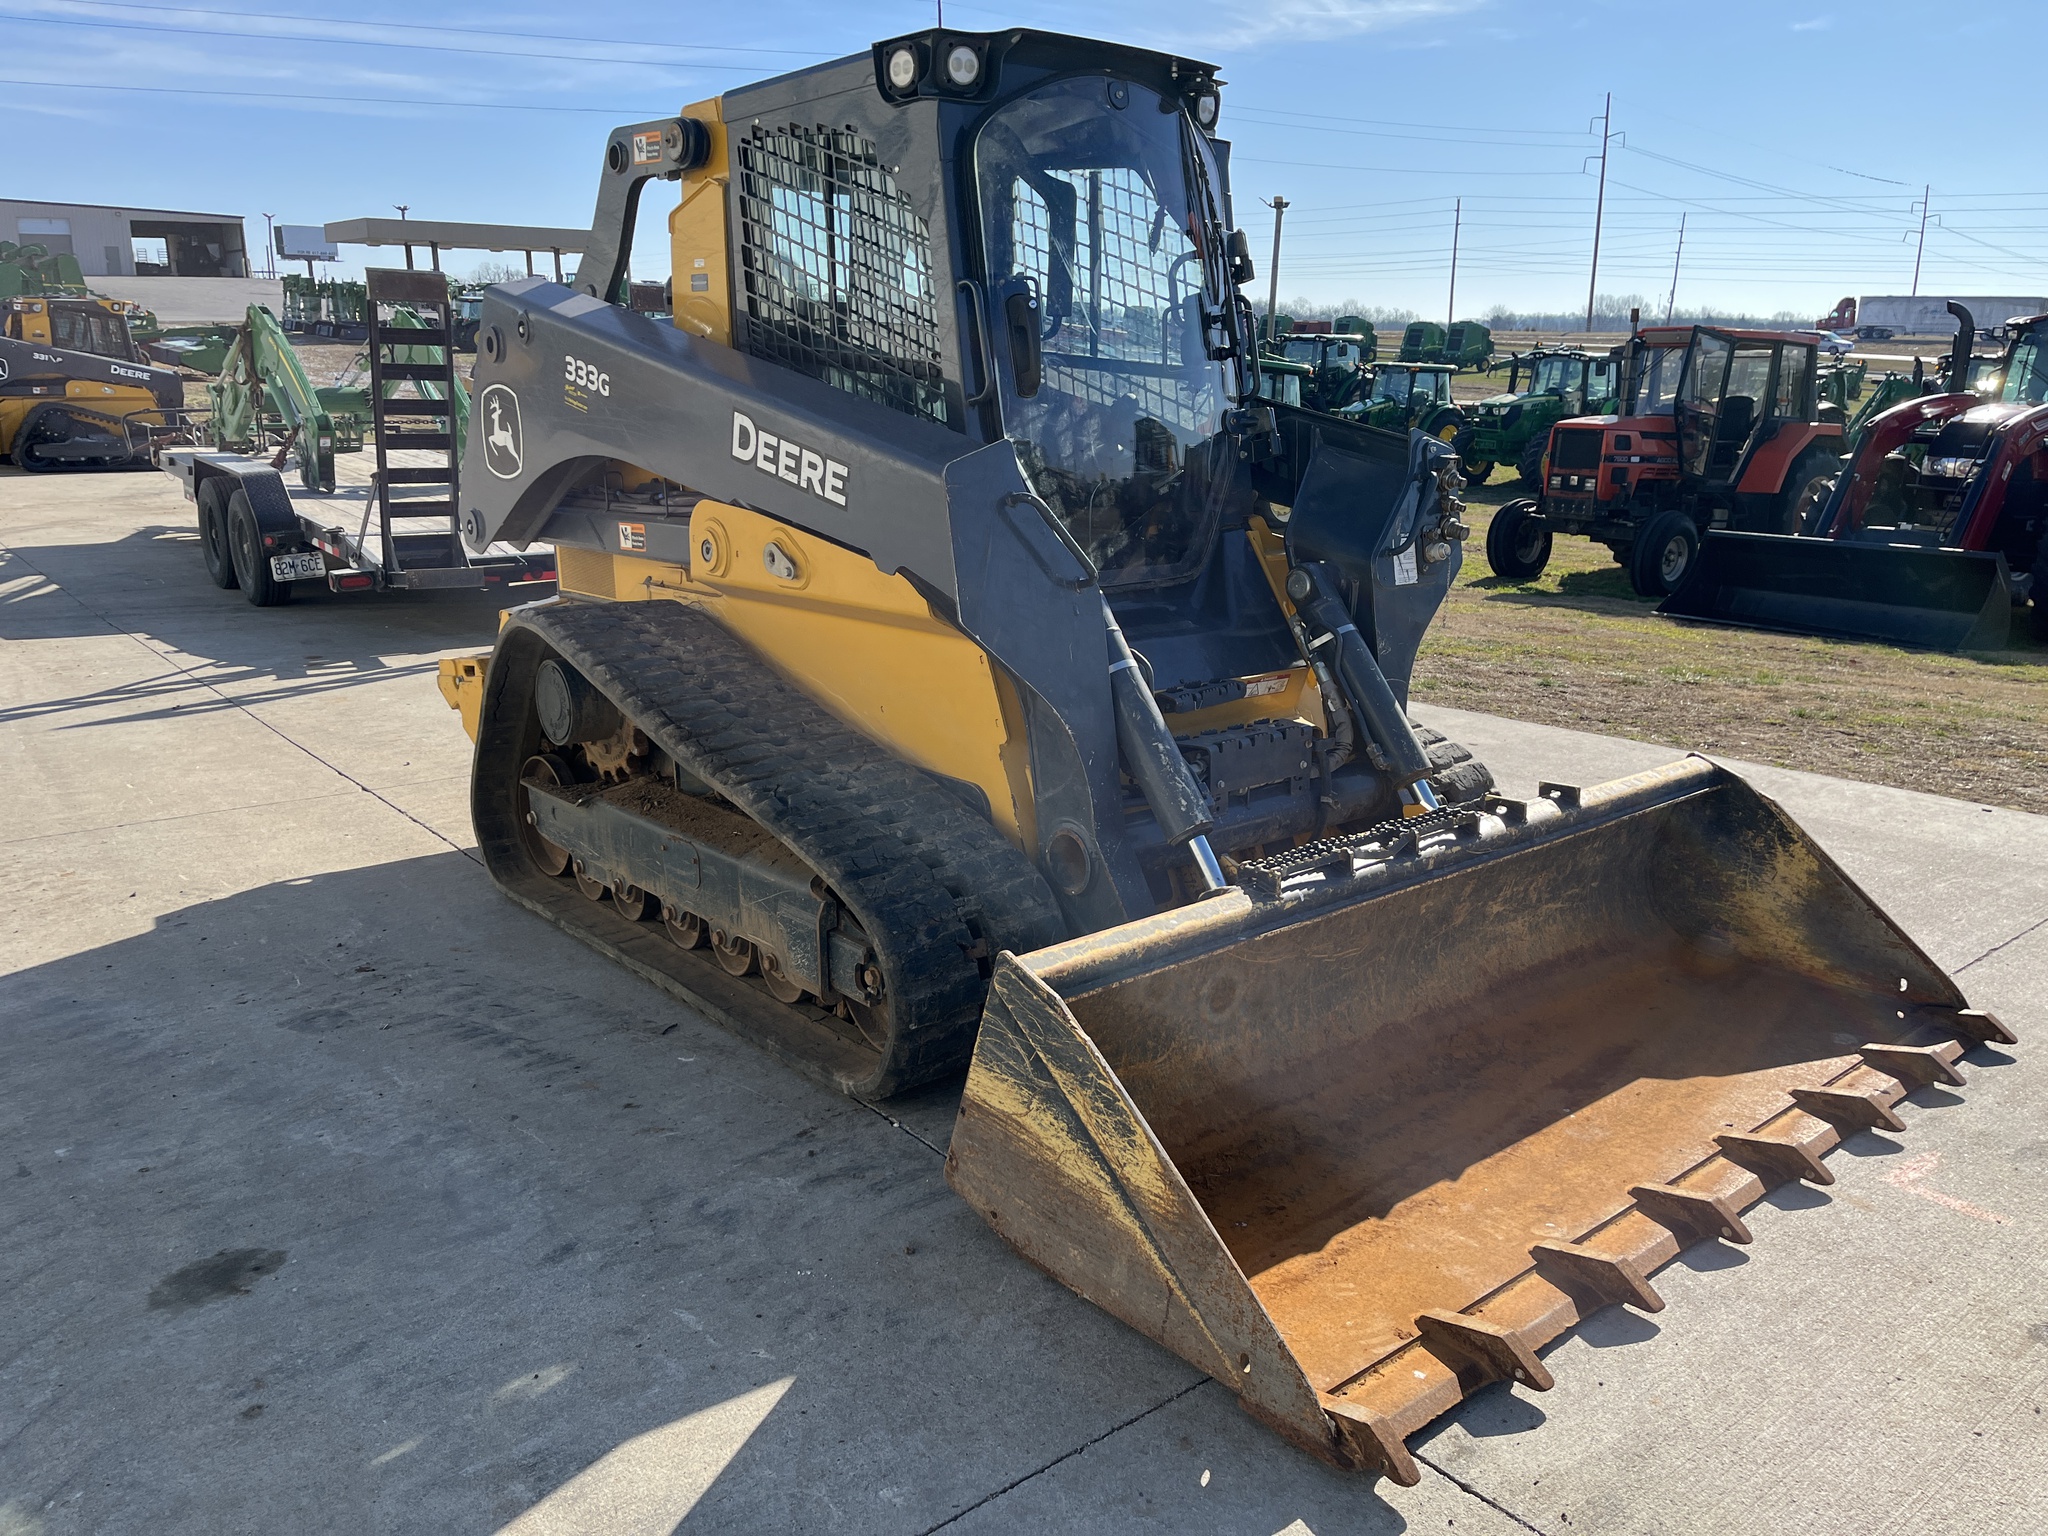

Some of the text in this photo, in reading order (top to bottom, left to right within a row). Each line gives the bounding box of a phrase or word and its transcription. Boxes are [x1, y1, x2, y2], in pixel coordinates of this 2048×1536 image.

[111, 365, 151, 380] DEERE
[565, 355, 610, 397] 333G
[732, 411, 849, 507] DEERE
[301, 558, 323, 572] 6CE
